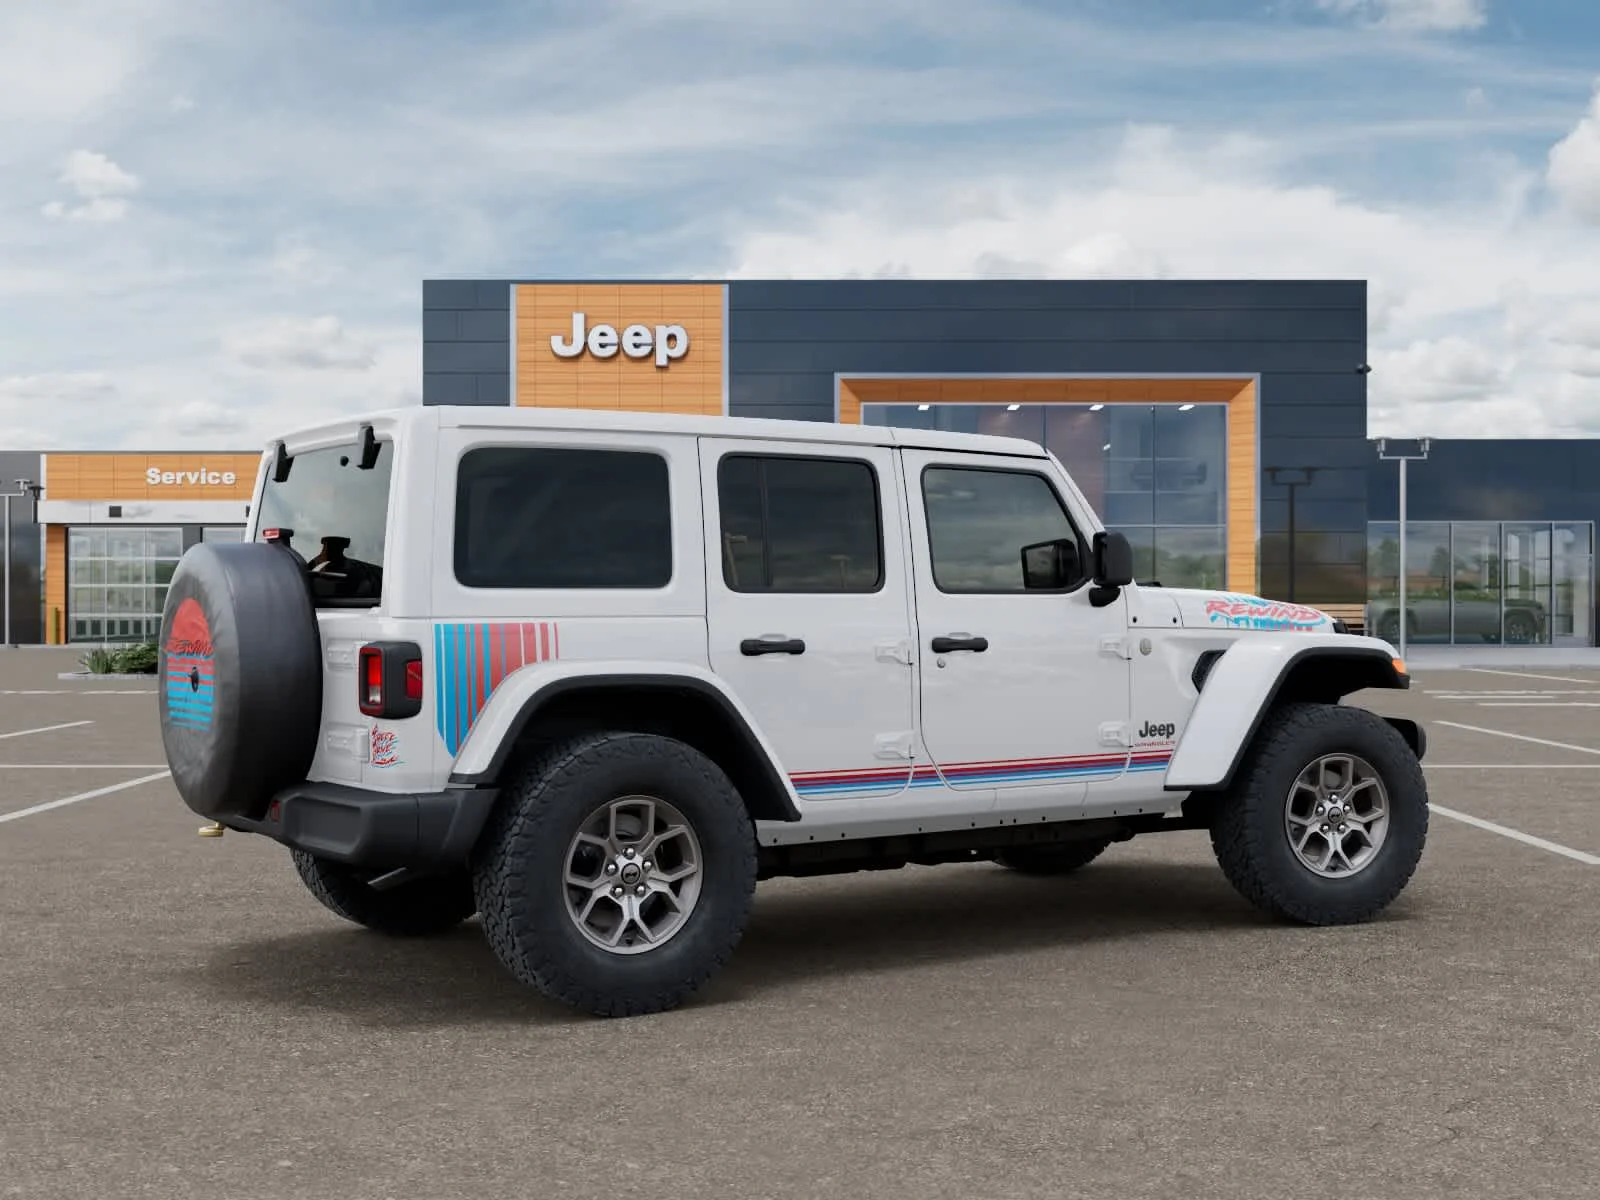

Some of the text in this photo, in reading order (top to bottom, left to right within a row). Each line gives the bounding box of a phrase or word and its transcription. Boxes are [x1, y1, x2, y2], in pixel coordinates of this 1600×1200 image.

[550, 312, 689, 368] Jeep
[146, 467, 236, 485] Service
[1206, 599, 1322, 620] REWIND
[1139, 720, 1175, 739] Jeep
